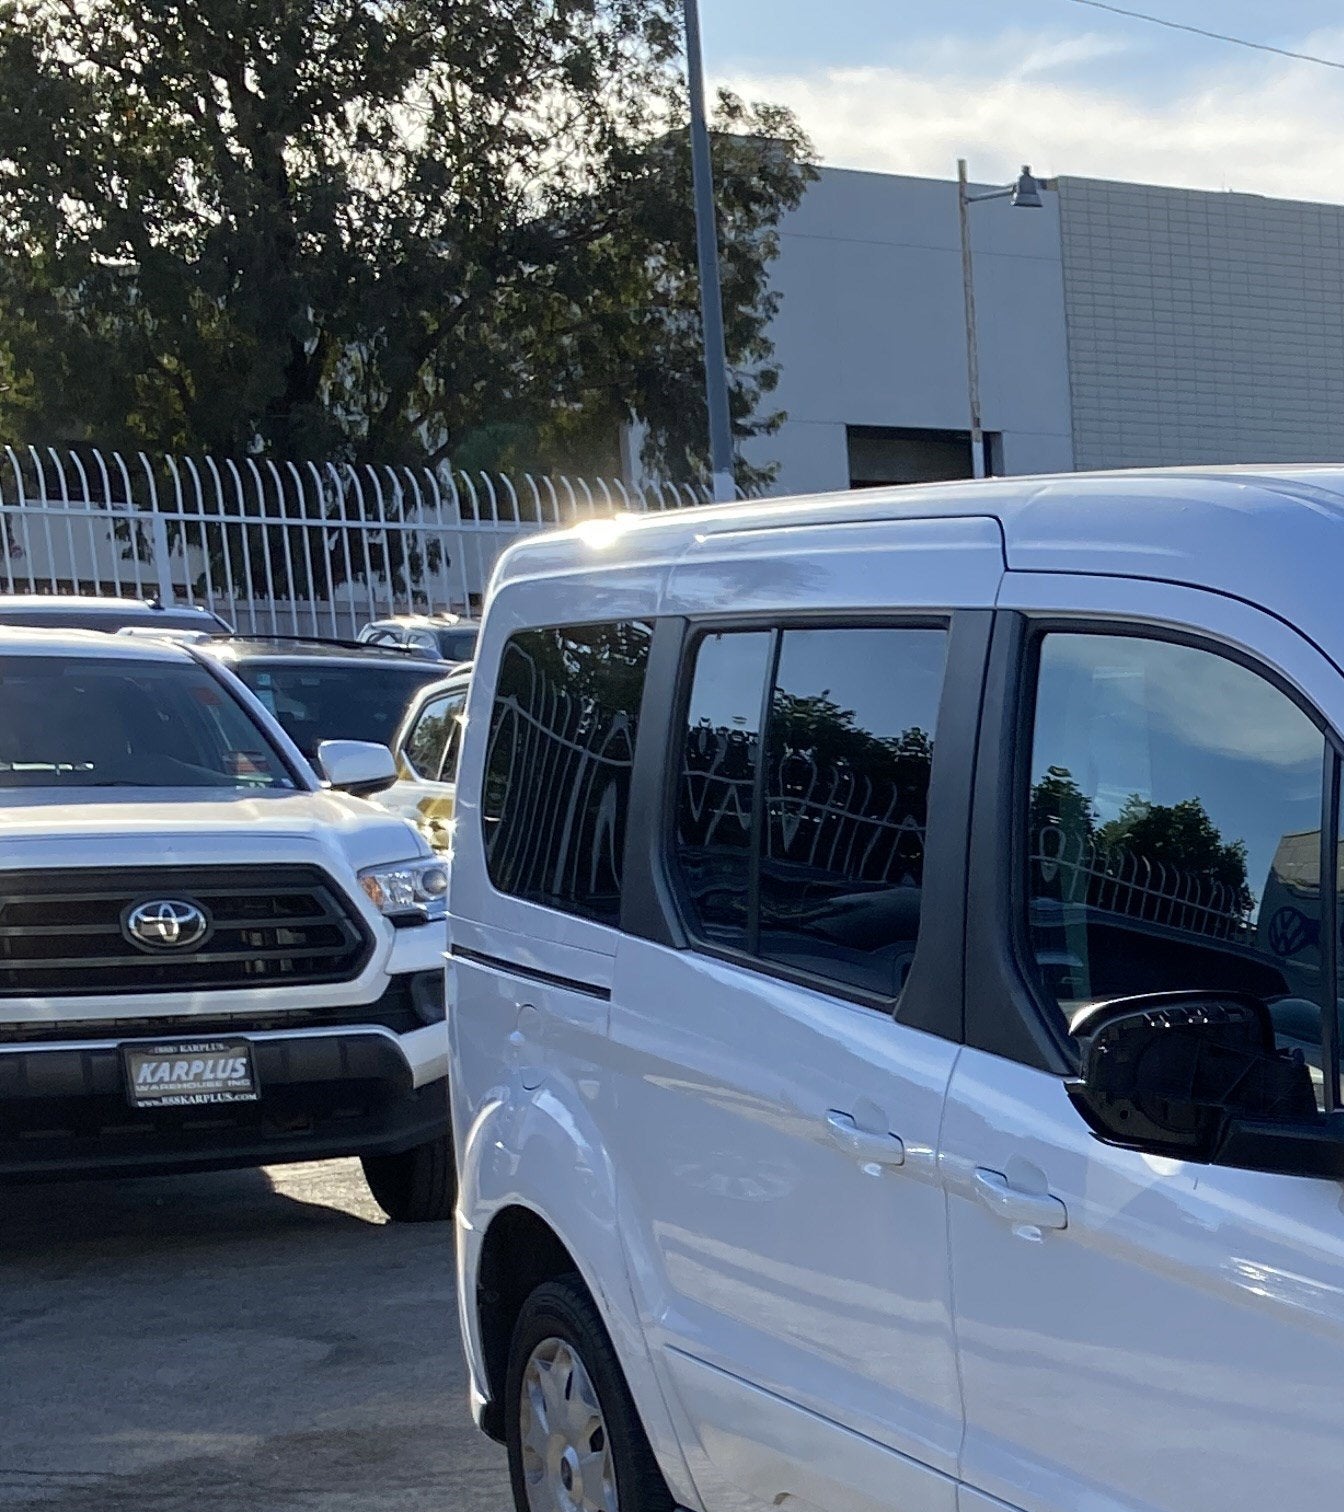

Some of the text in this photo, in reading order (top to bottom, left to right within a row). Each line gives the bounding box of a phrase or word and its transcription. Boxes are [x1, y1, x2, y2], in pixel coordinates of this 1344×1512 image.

[180, 1042, 224, 1053] KARPLUS
[137, 1057, 247, 1083] KARPLUS
[136, 1080, 223, 1092] WAREHOUSE
